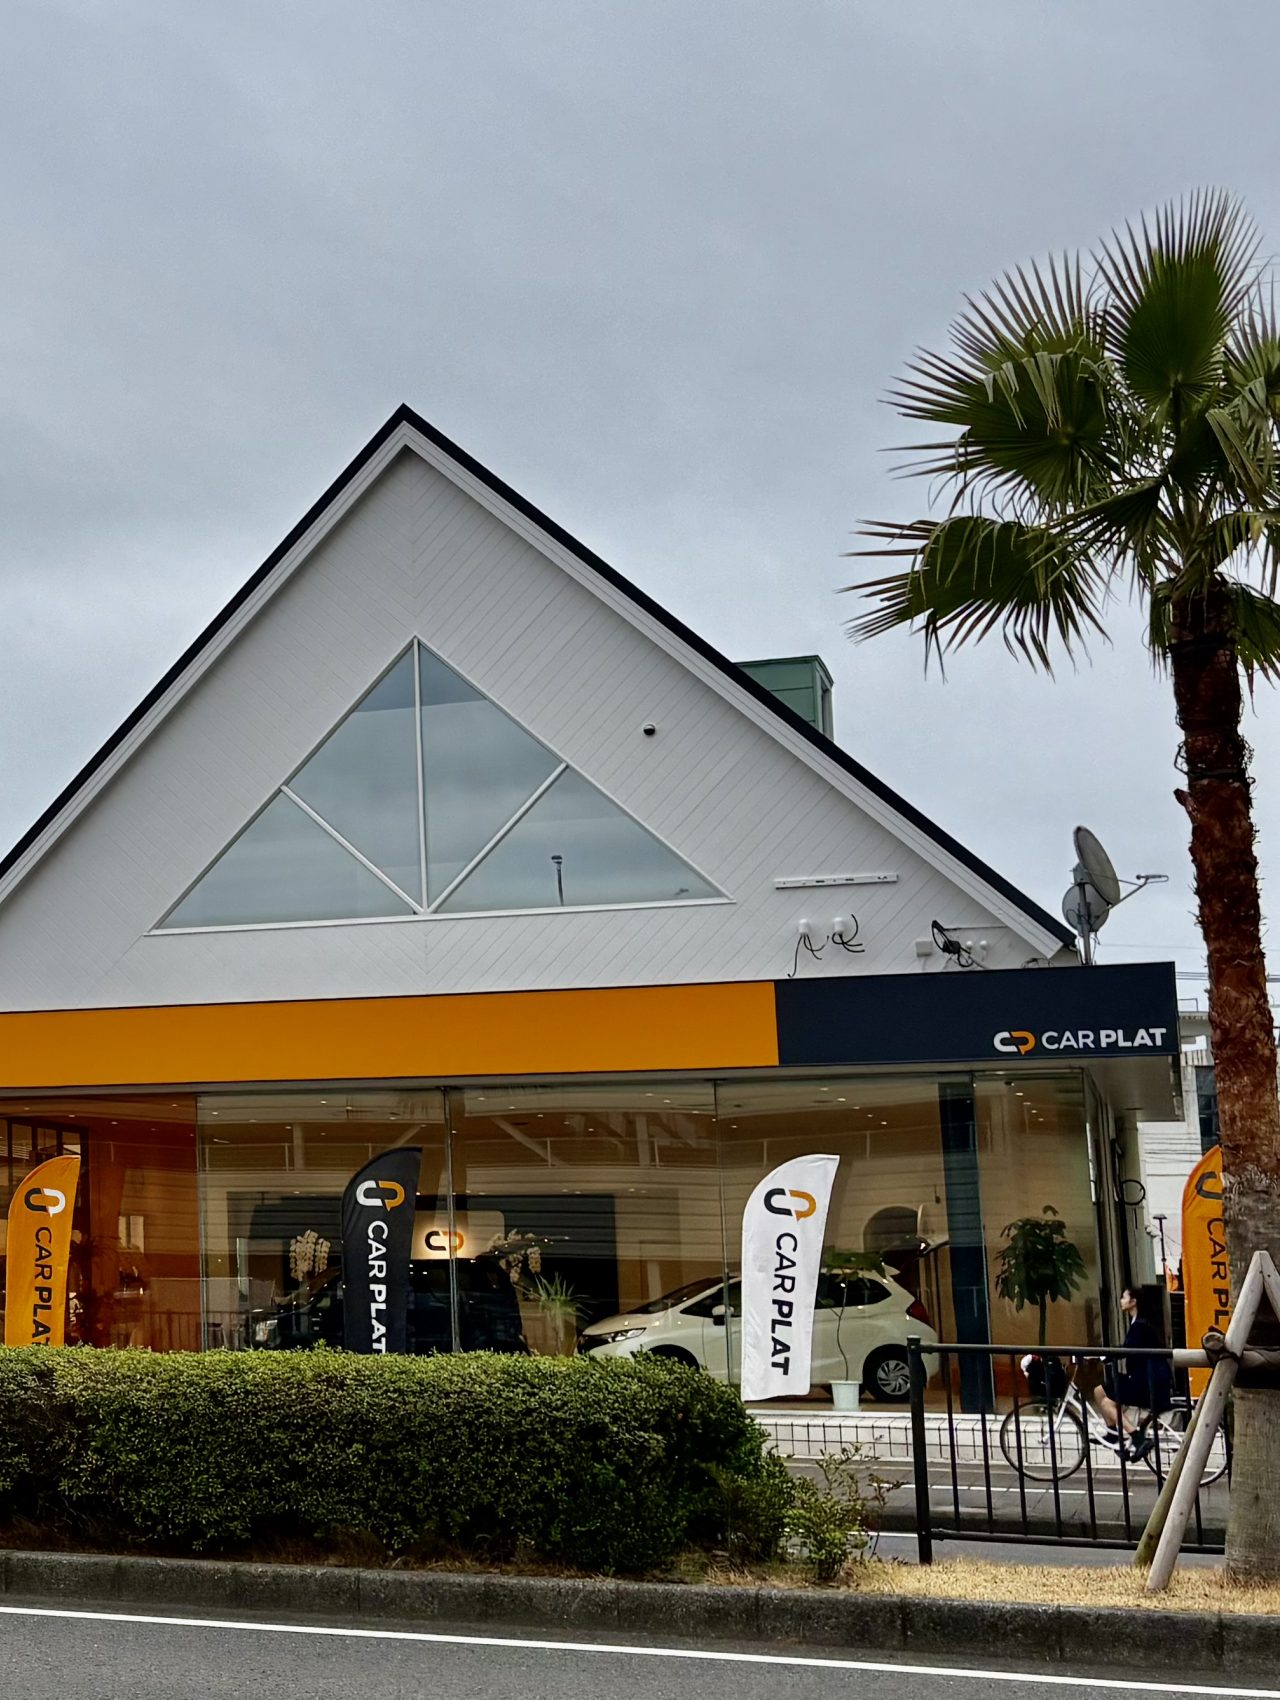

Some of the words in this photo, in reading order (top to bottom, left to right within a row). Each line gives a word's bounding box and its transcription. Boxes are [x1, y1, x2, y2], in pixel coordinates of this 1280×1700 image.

[1041, 1030, 1095, 1050] CAR
[1099, 1027, 1167, 1048] PLAT
[34, 1226, 53, 1280] CAR
[368, 1220, 389, 1279] CAR
[773, 1232, 798, 1294] CAR
[771, 1299, 794, 1376] PLAT
